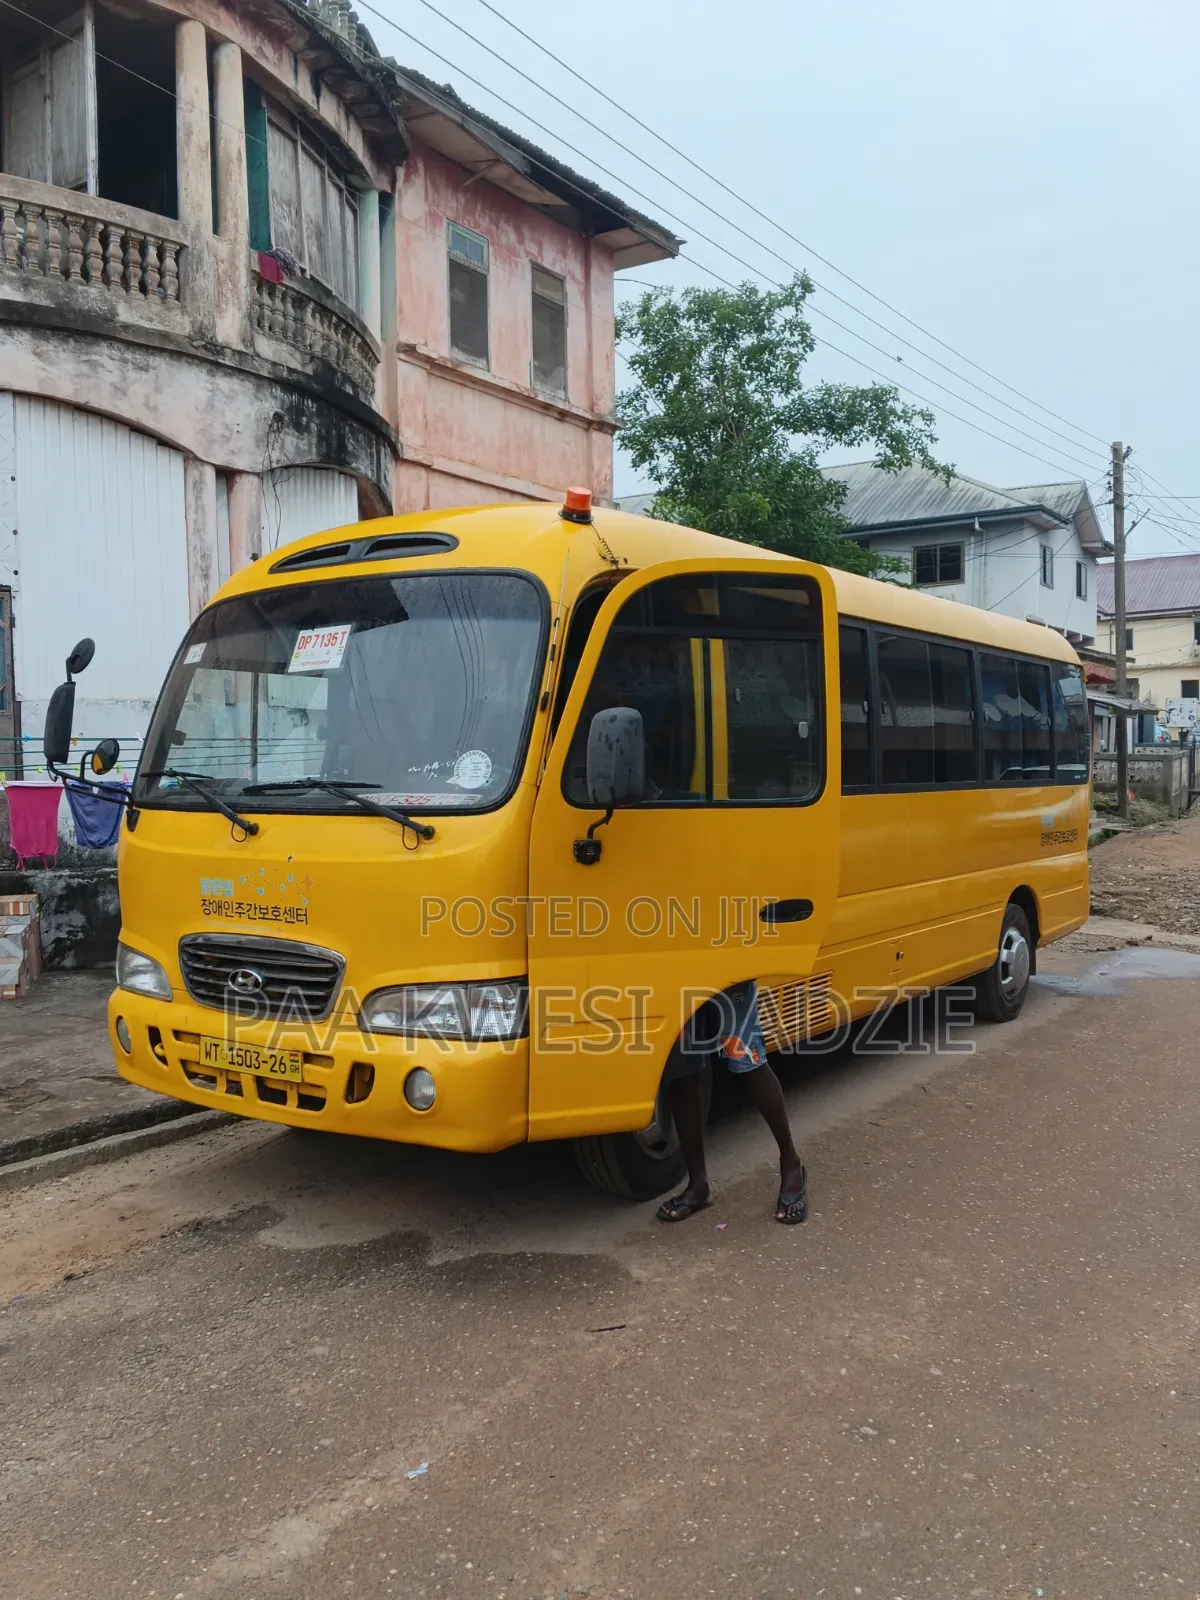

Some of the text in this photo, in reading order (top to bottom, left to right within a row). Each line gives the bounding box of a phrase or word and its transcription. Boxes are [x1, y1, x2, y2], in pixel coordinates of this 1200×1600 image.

[297, 635, 312, 650] DP
[312, 632, 338, 649] 7135
[200, 898, 308, 925] 장애인주간보호센터
[204, 1041, 287, 1075] WT 1503-26
[289, 1064, 300, 1073] GH
